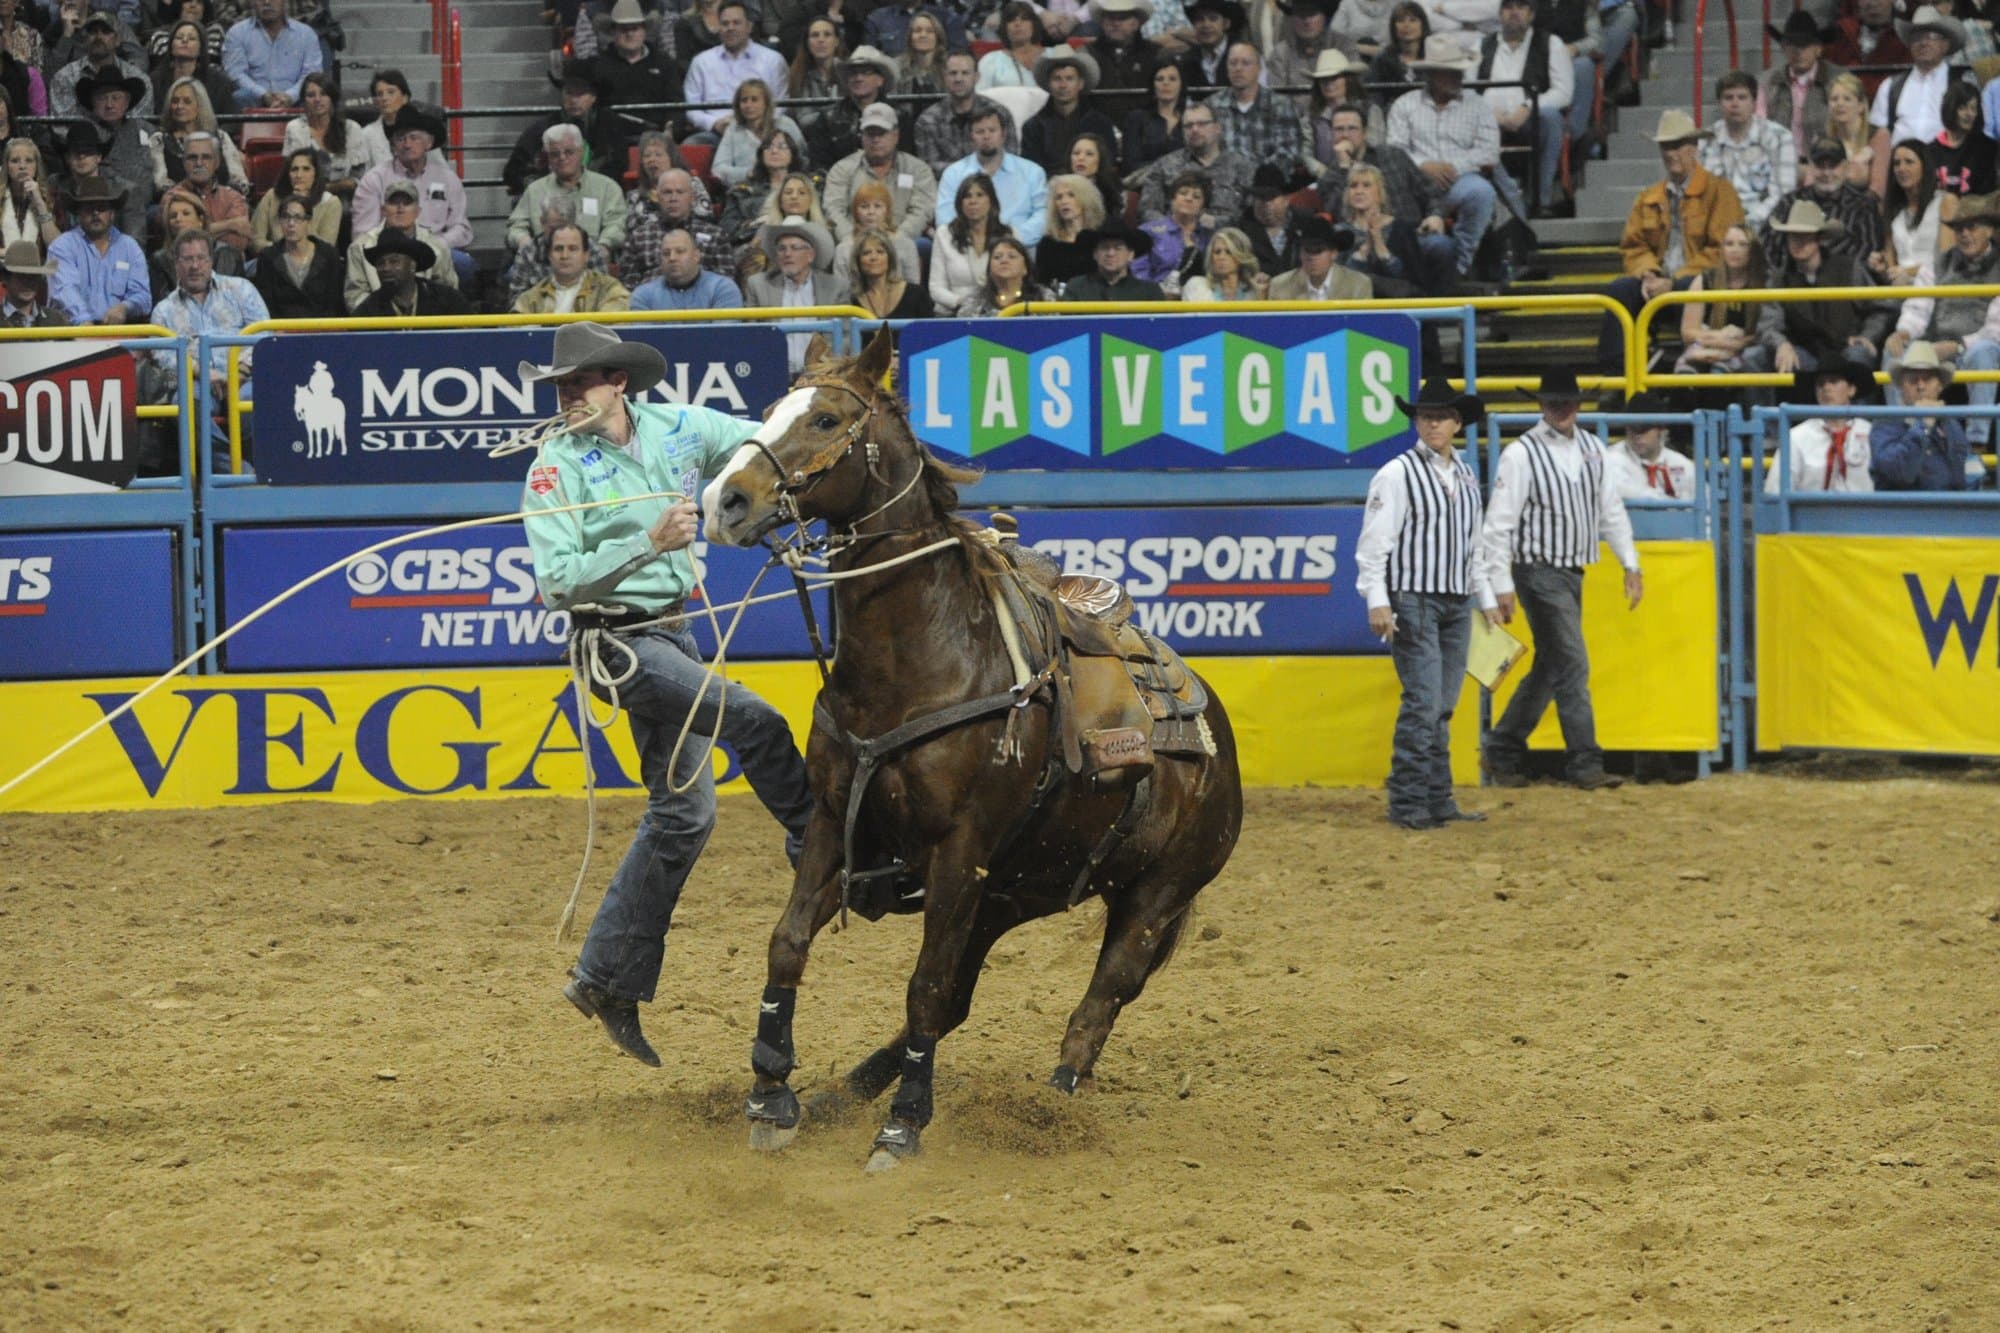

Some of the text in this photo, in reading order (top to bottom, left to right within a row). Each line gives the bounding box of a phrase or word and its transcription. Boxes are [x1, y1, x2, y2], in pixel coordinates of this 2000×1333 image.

[361, 362, 748, 418] MONNA
[924, 350, 1395, 428] LAS VEGAS
[361, 423, 566, 452] SILVER
[421, 609, 571, 647] NETWO
[1135, 601, 1265, 638] WORK
[80, 684, 744, 798] VEGA
